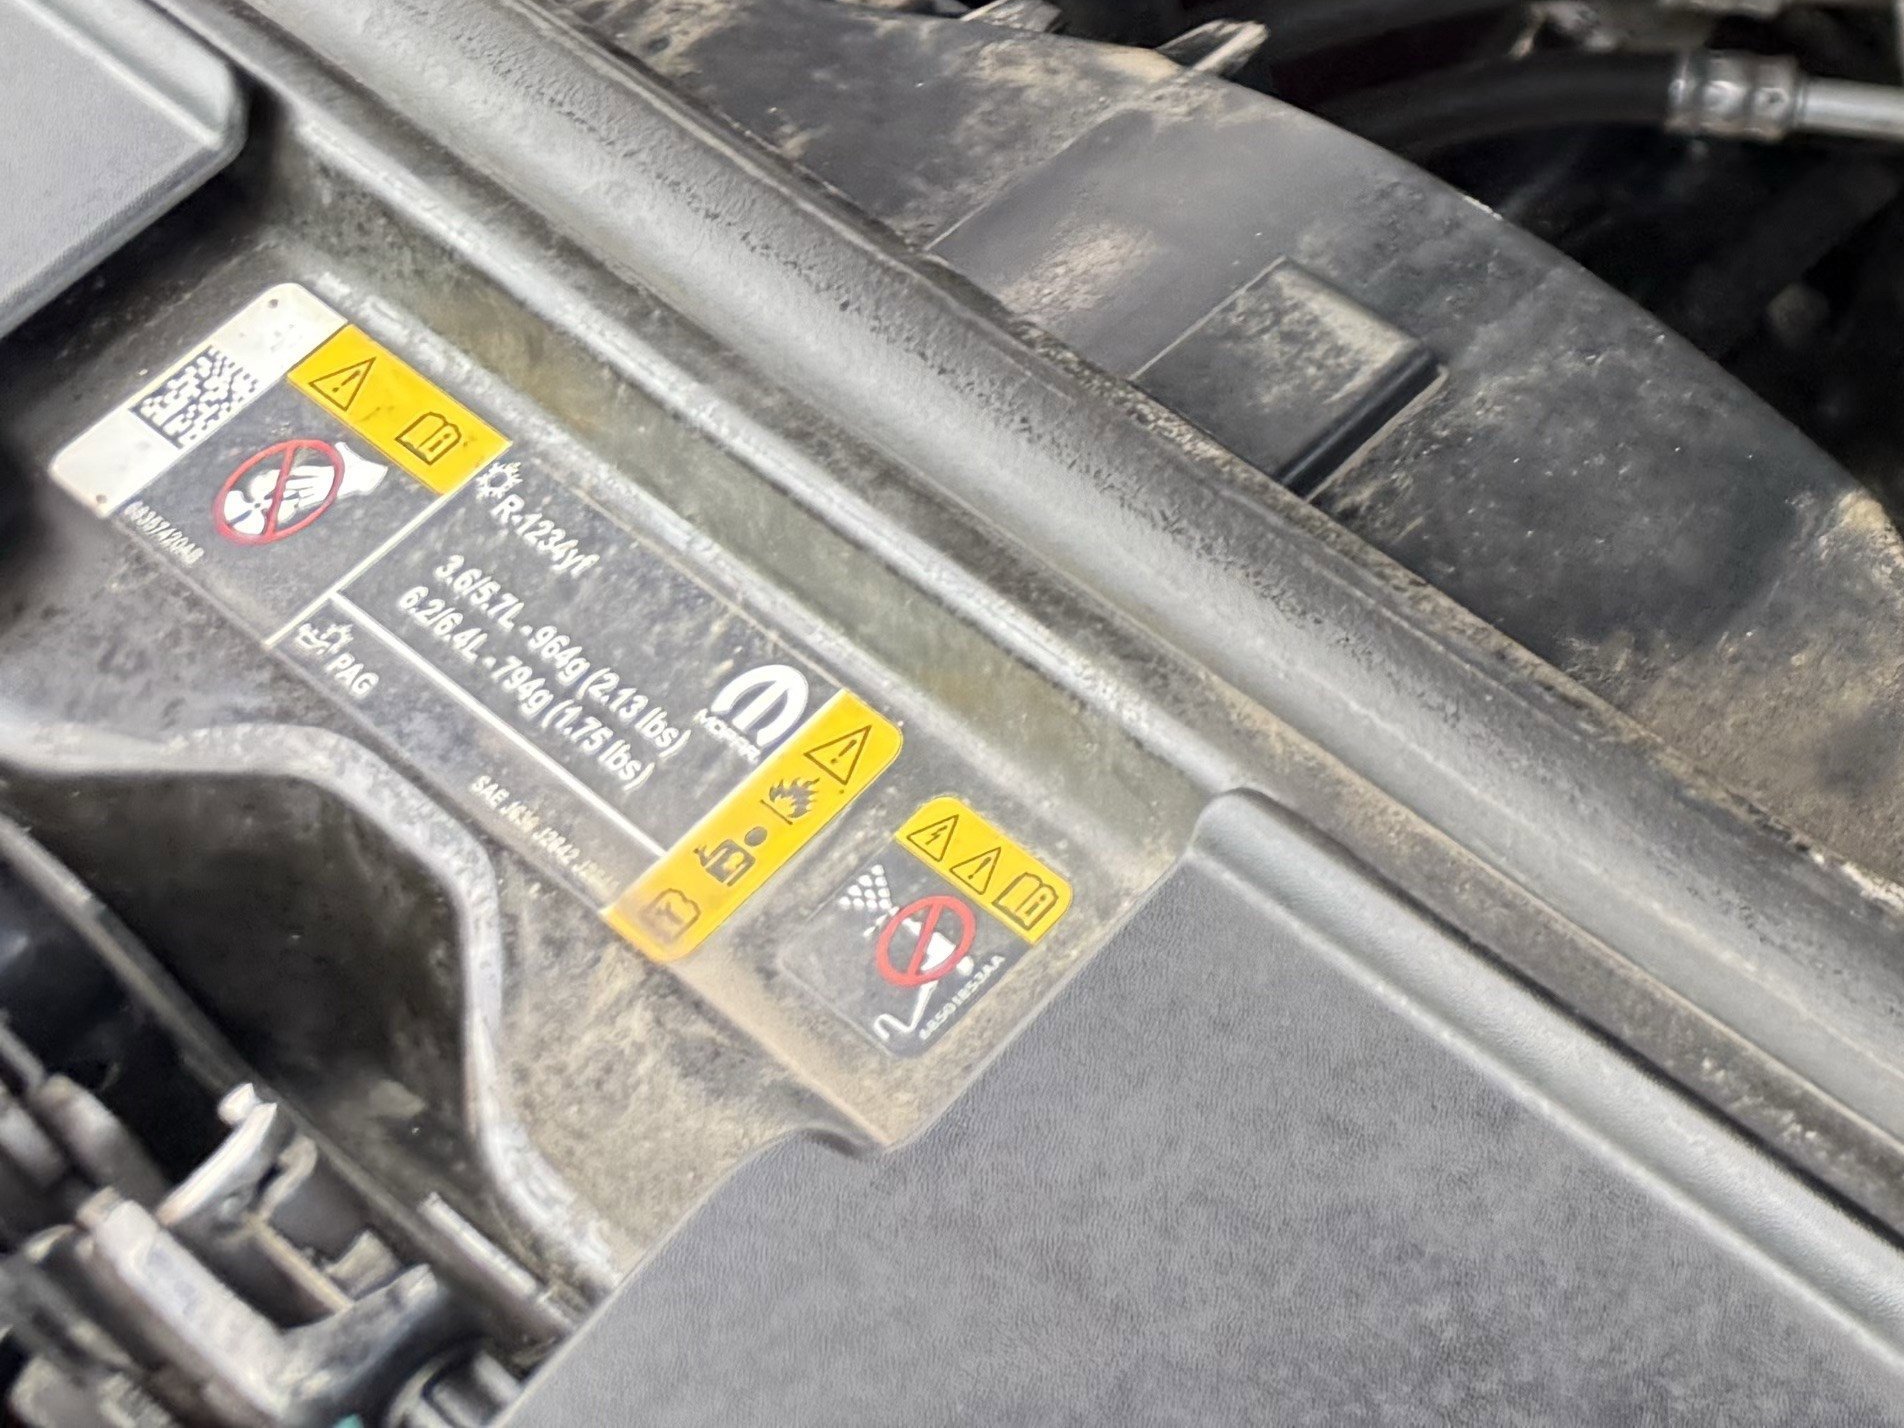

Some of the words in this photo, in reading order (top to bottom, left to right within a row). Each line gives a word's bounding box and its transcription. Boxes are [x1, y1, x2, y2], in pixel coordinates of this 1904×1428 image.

[491, 493, 600, 579] R-1234yf
[323, 652, 380, 700] PAG
[398, 585, 488, 664] 6.2/6.4L
[492, 655, 554, 720] 794g
[542, 698, 613, 757] (1.75
[599, 737, 656, 792] lbs)
[434, 554, 525, 630] 3.6/5.7L
[528, 625, 591, 685] 964g
[576, 667, 648, 723] (2.13
[634, 706, 692, 759] lbs)
[468, 774, 509, 811] SAE
